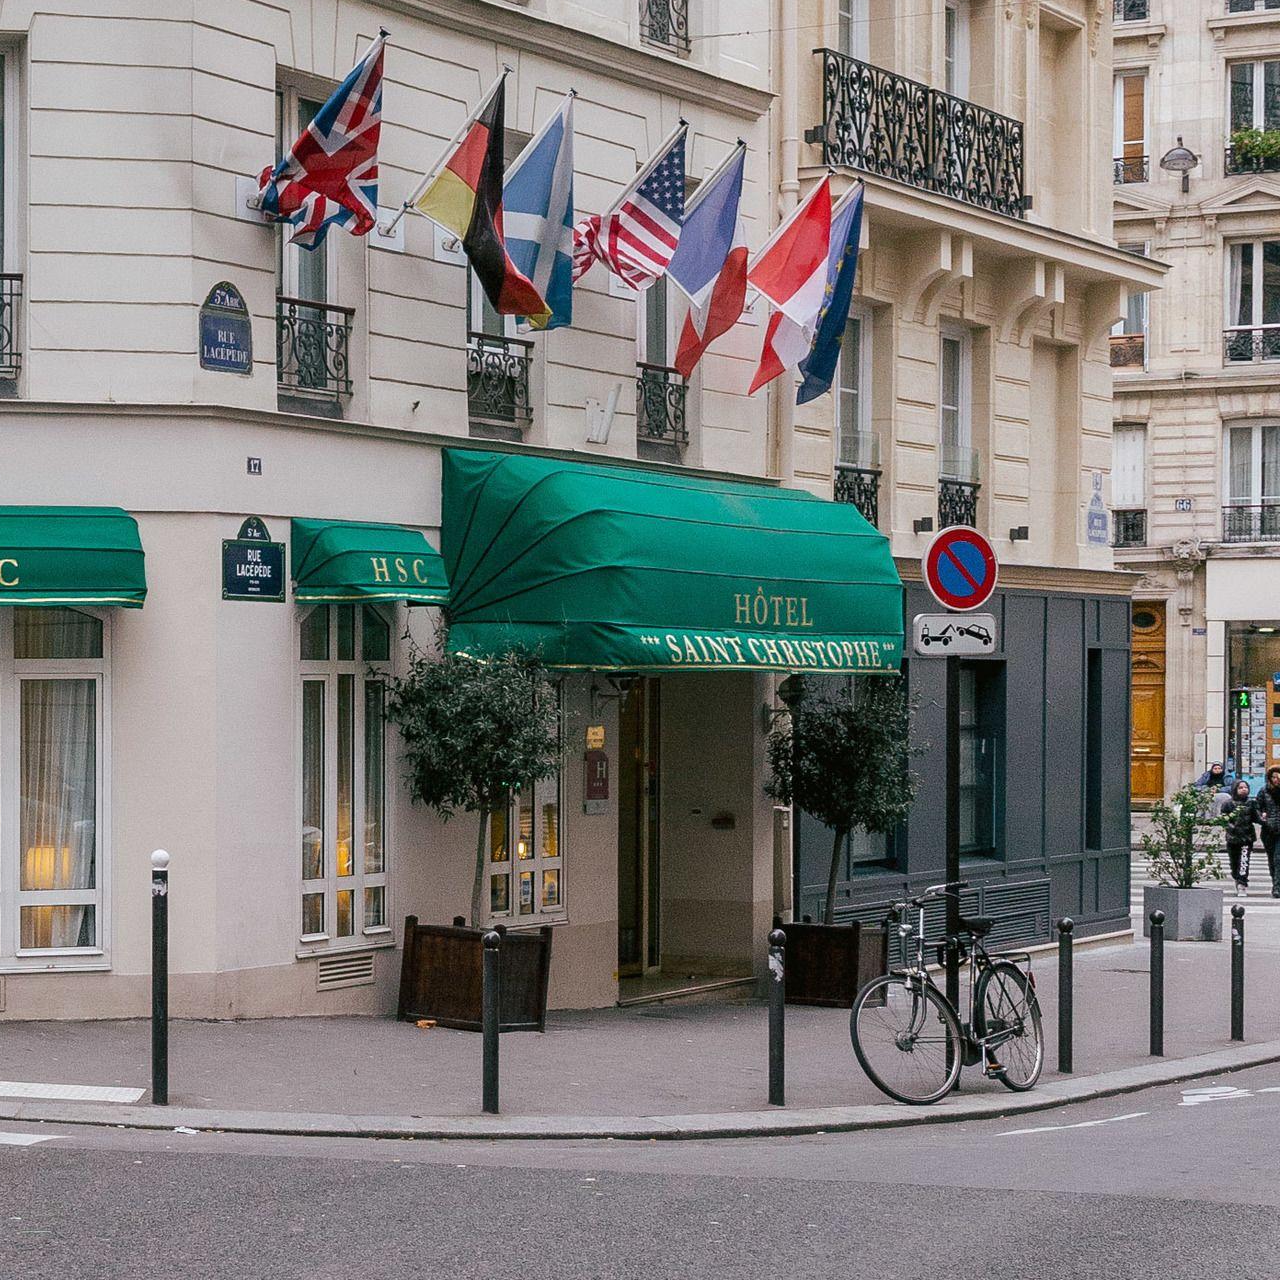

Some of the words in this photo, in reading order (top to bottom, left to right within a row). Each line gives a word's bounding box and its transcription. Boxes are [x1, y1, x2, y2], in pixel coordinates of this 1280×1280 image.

[218, 330, 235, 344] RUE
[250, 460, 259, 473] 17
[1176, 500, 1191, 511] 66
[247, 549, 261, 562] RUE
[734, 586, 813, 627] HÔTEL
[665, 634, 746, 663] SAINT
[747, 637, 882, 668] CHRISTOPHE
[597, 761, 606, 779] H
